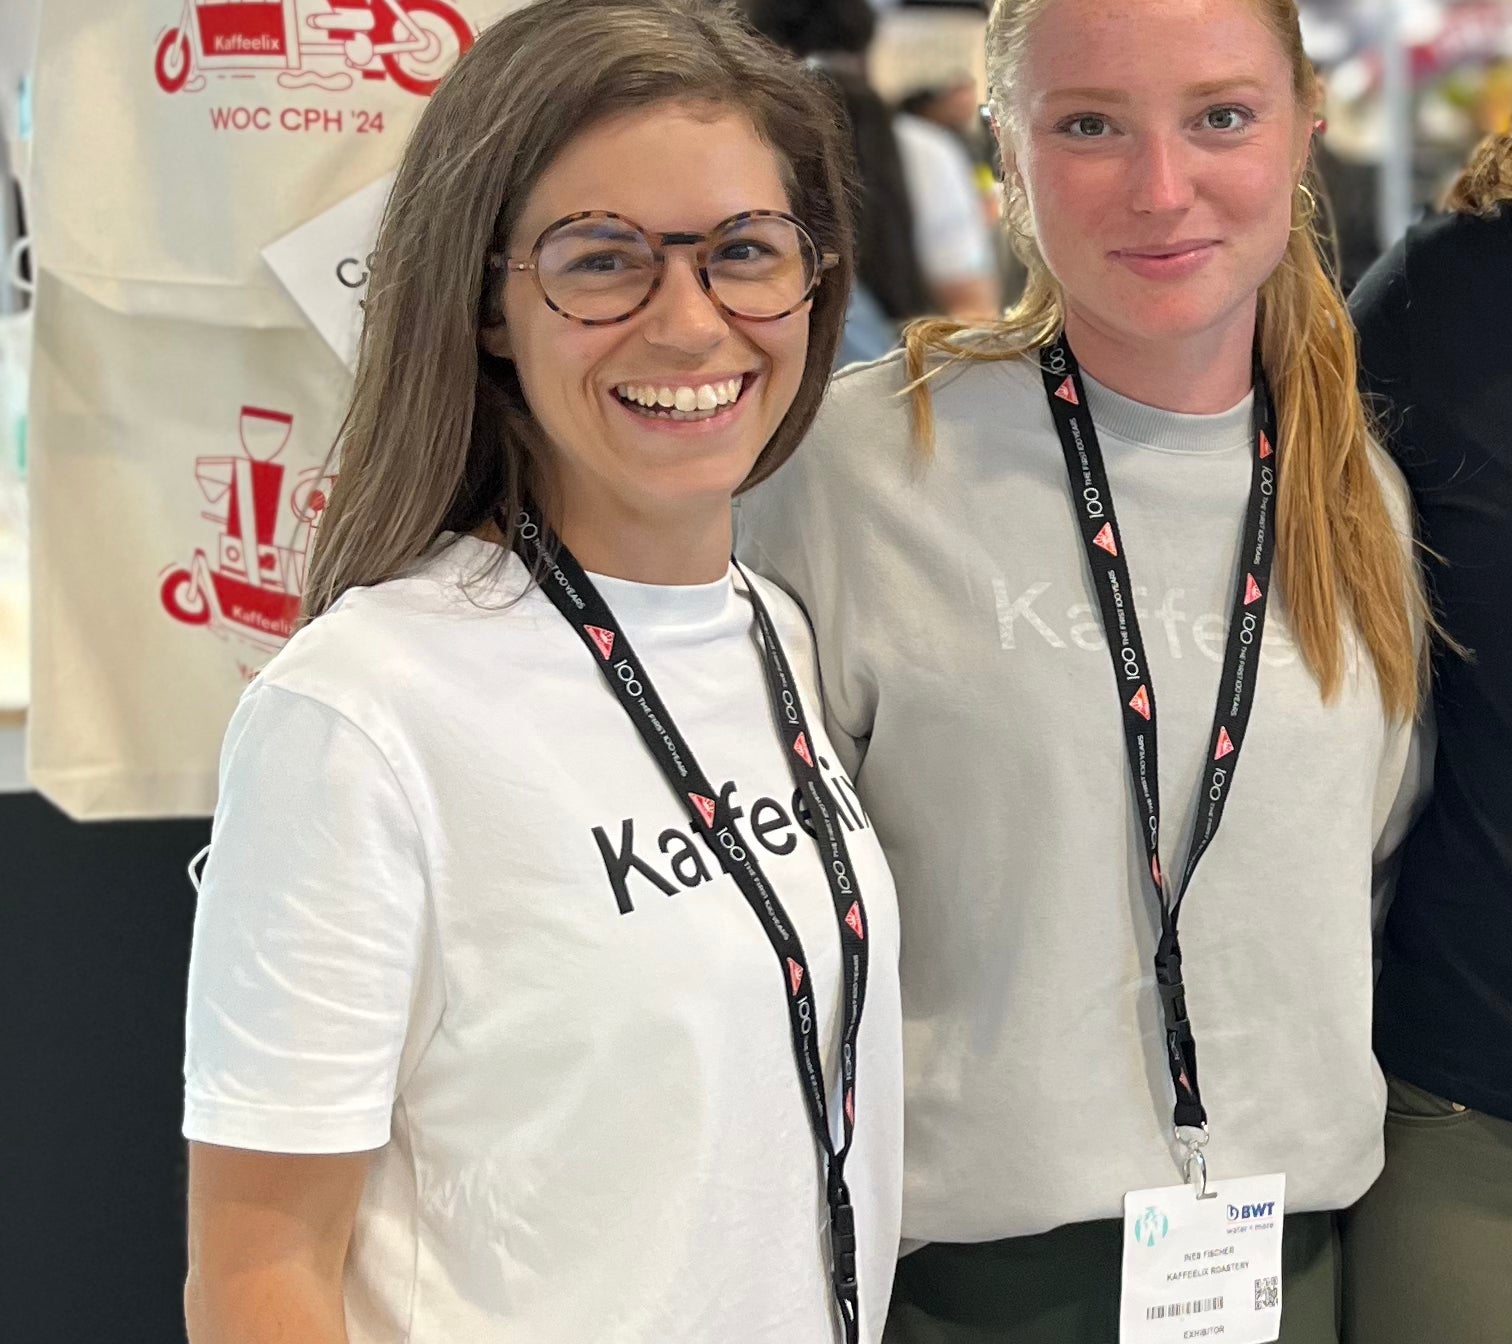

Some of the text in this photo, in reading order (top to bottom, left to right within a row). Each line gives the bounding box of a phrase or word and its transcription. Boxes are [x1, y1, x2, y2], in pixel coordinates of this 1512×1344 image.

[214, 34, 280, 51] Kaffeelix
[210, 106, 385, 134] WOC CPH '24
[1258, 465, 1275, 495] 100
[1082, 485, 1104, 520] 100
[510, 509, 539, 542] 00
[1107, 568, 1119, 593] YEARS
[1113, 591, 1123, 608] 100
[1120, 630, 1129, 645] THE
[1238, 611, 1257, 645] 100
[612, 658, 645, 698] 100
[1120, 645, 1140, 681] 100
[779, 688, 799, 726] 100
[1205, 766, 1228, 801] 100
[715, 825, 747, 864] 100
[830, 858, 853, 896] 100
[796, 995, 813, 1034] 100
[1241, 1201, 1275, 1220] BWT
